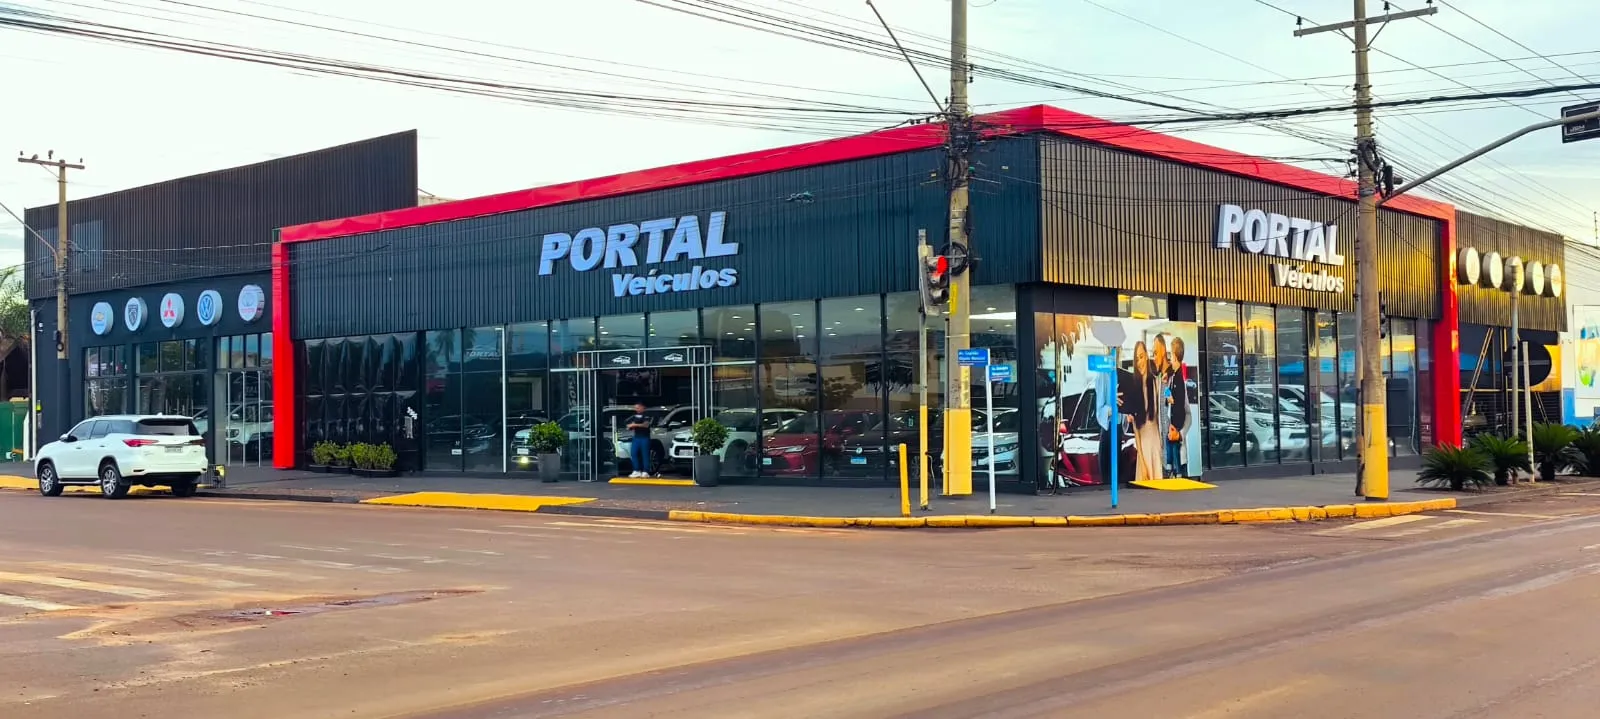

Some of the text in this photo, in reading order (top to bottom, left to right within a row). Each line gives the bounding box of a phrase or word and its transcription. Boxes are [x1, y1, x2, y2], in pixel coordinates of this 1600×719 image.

[538, 211, 739, 276] PORTAL
[1216, 204, 1345, 266] PORTAL
[612, 265, 738, 298] Veículos
[1272, 263, 1345, 294] Veículos
